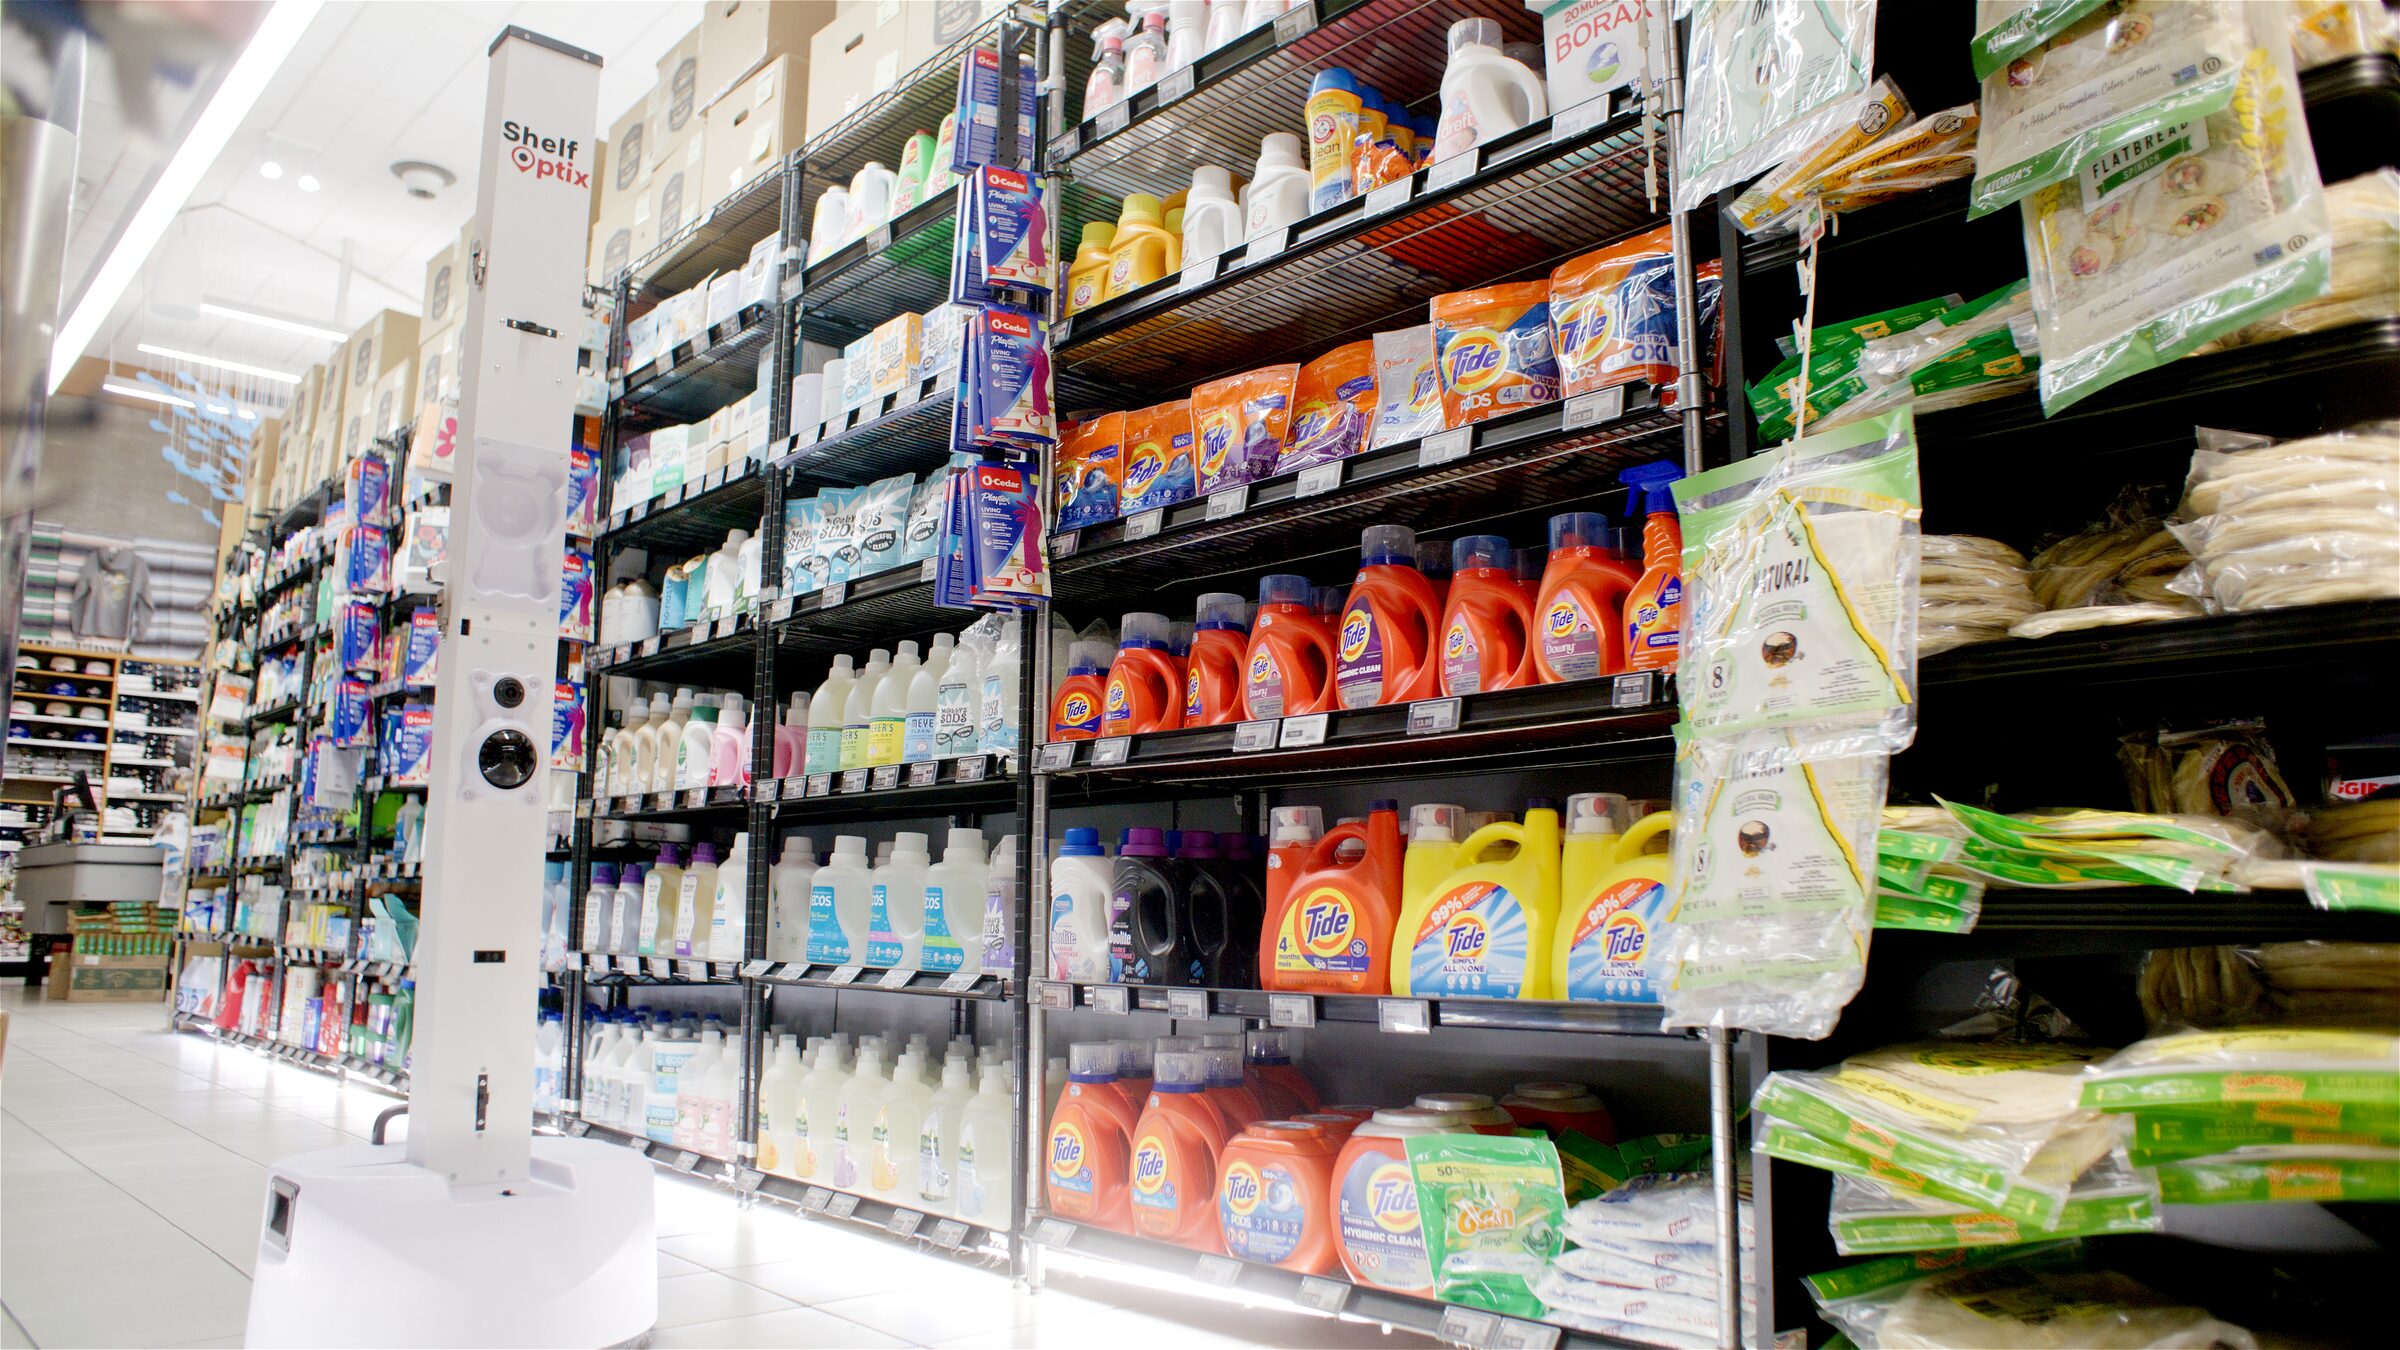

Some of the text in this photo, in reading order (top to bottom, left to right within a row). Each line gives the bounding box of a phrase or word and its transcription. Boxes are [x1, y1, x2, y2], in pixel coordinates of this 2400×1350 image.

[1564, 7, 1579, 24] 20
[1556, 0, 1653, 64] BORAX
[1441, 112, 1473, 138] dreft
[503, 120, 579, 160] Shelf
[1315, 142, 1340, 158] lean
[511, 146, 589, 189] Optix
[2123, 153, 2161, 180] SPINACH
[1984, 166, 2033, 196] ATORIA'S
[991, 319, 1028, 334] O-Cedar
[1560, 310, 1608, 356] Tide
[991, 335, 1019, 348] Playtex
[1634, 335, 1665, 344] ULTRA
[1631, 345, 1669, 361] OXI
[1450, 345, 1501, 386] Tide
[1568, 364, 1597, 384] ODS
[1535, 375, 1560, 387] ULTRA
[1201, 426, 1232, 469] Tide
[981, 475, 1020, 488] O-Cedar
[1122, 456, 1163, 489] Tide
[981, 492, 1011, 505] Playtex
[788, 537, 812, 551] SUD
[865, 532, 894, 546] POWERFUL
[872, 541, 890, 550] CLEAN
[1551, 611, 1574, 632] Tide
[1638, 608, 1658, 627] Tide
[1342, 622, 1366, 656] Tide
[1449, 633, 1463, 649] Tide
[1546, 643, 1575, 655] Downy
[1252, 660, 1268, 678] Tide
[1359, 664, 1381, 674] CLEAN
[1713, 666, 1723, 688] 8
[1108, 688, 1123, 704] Tide
[941, 713, 967, 724] SUDS
[1066, 701, 1088, 721] Tide
[912, 719, 934, 728] MEYE
[811, 894, 832, 906] ECOS
[1588, 894, 1620, 926] 99%
[1431, 896, 1462, 926] 99%
[1306, 905, 1350, 945] Tide
[1449, 926, 1485, 957] Tide
[1607, 927, 1645, 960] Tide
[1053, 1137, 1081, 1165] Tide
[1137, 1151, 1164, 1182] Tide
[1229, 1176, 1257, 1202] Tide
[1374, 1182, 1417, 1217] Tide
[1231, 1214, 1252, 1228] PODS
[1457, 1206, 1516, 1237] Gain
[1344, 1227, 1421, 1247] HYGIENIC CLEAN
